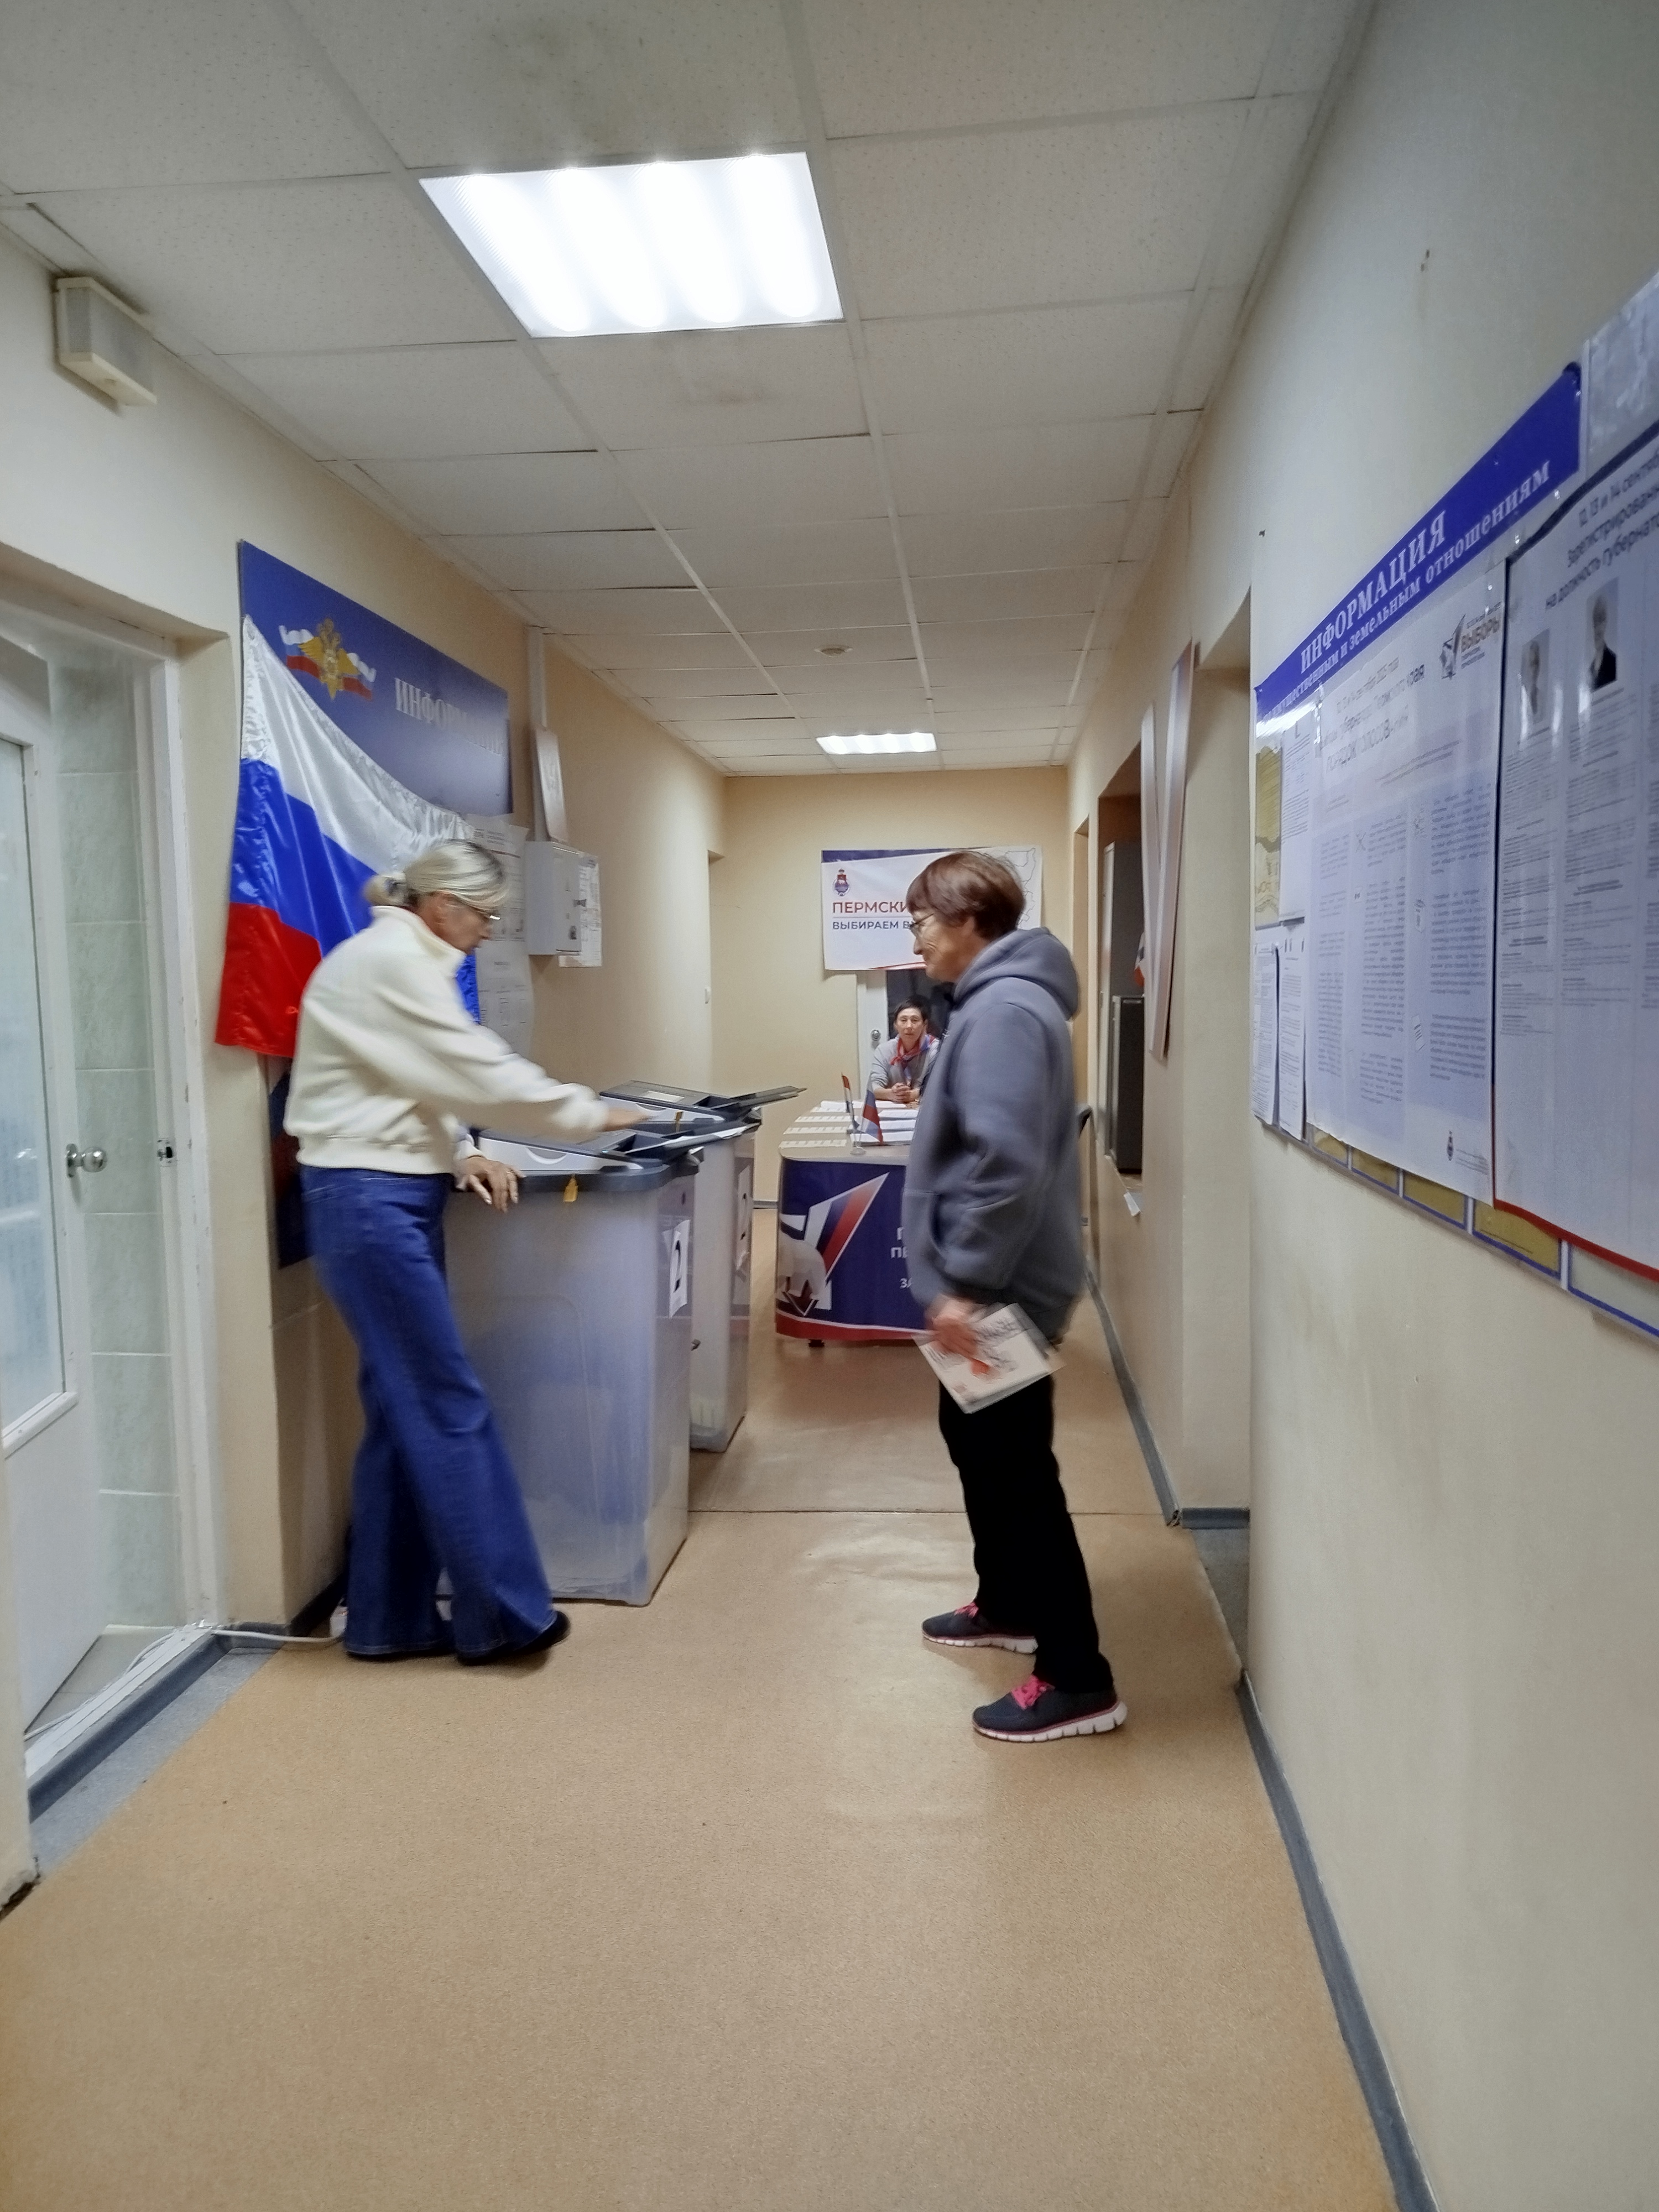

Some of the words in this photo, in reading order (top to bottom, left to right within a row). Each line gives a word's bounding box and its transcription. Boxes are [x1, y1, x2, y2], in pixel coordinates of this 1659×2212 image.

[1301, 509, 1446, 674] ИНФОРМАЦИЯ
[1349, 576, 1421, 650] земельным
[1425, 460, 1550, 584] отношениям
[833, 921, 899, 930] ВЫБИРАЕМ
